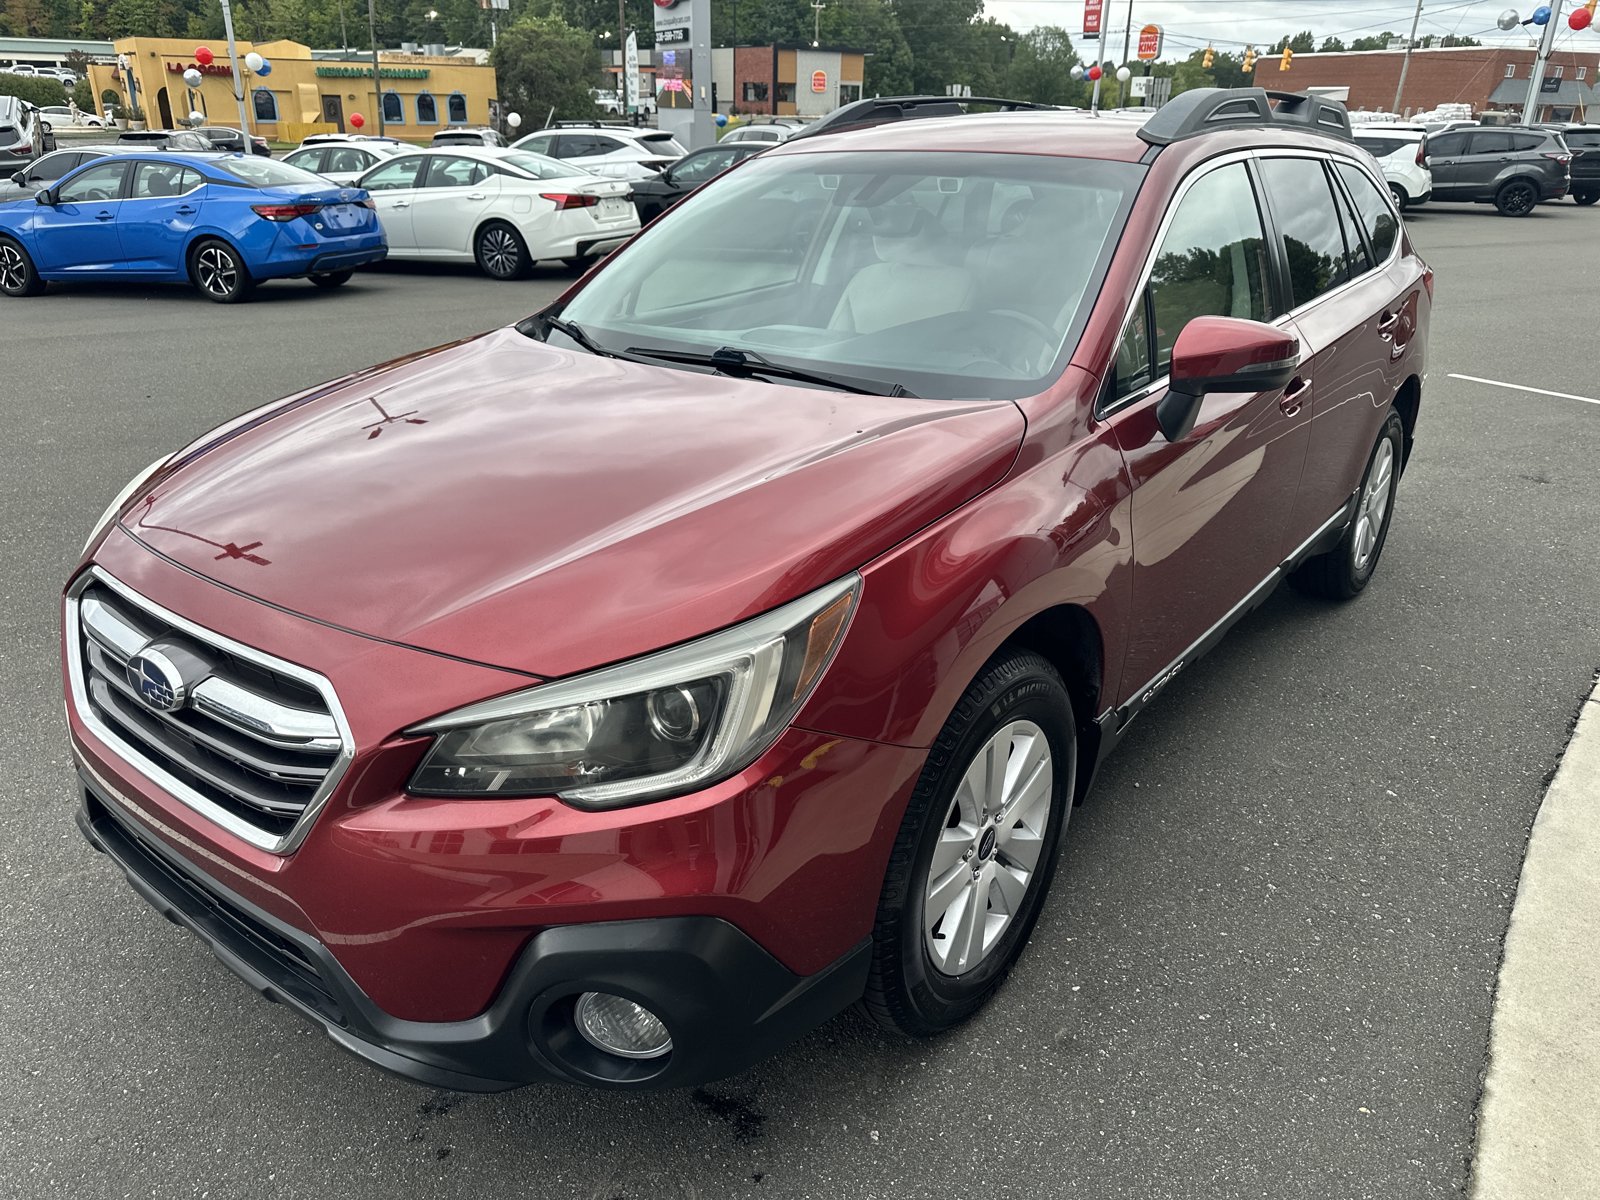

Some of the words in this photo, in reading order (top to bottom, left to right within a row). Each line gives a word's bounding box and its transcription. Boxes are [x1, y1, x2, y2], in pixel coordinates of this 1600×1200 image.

[1138, 42, 1157, 53] KING
[167, 62, 184, 73] LA
[187, 63, 234, 78] COCIN
[316, 67, 364, 78] MEXICAN
[367, 68, 431, 79] RSTAURANT
